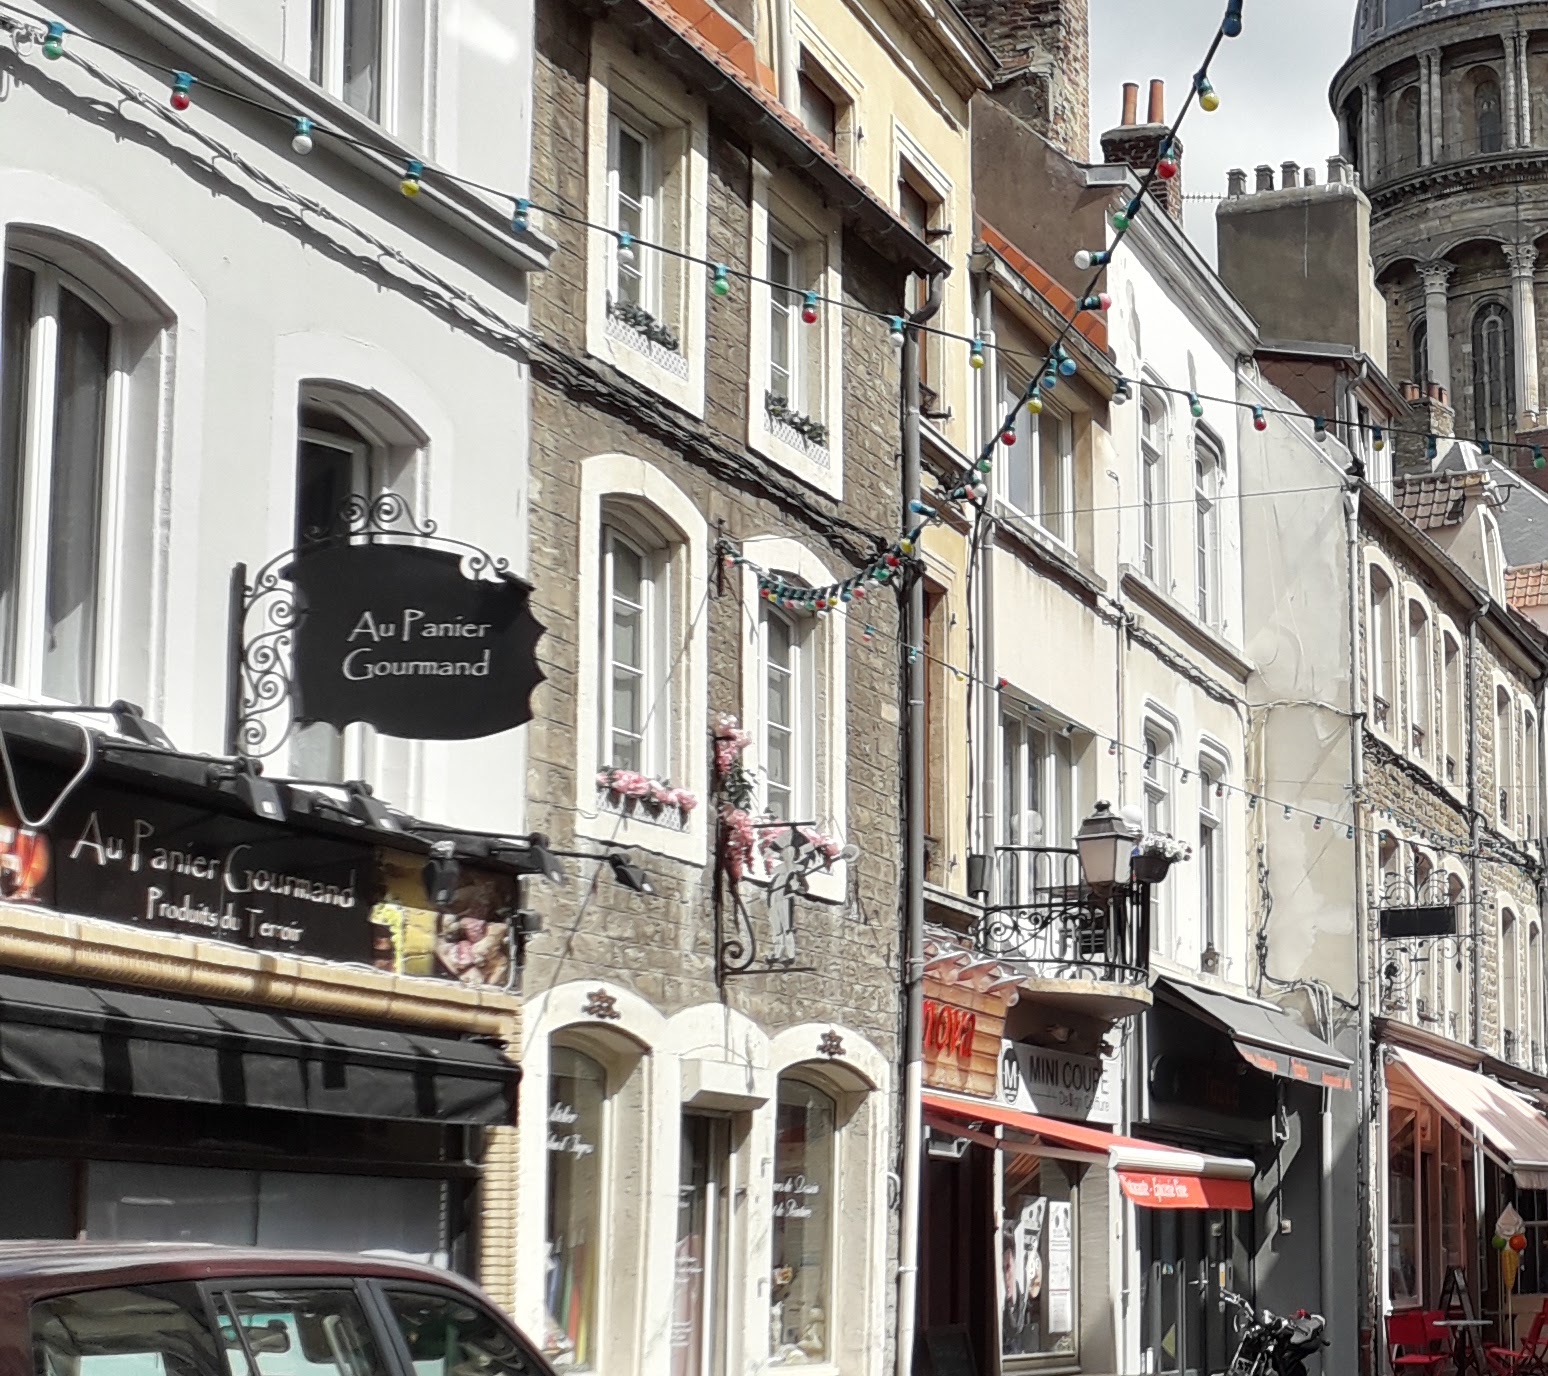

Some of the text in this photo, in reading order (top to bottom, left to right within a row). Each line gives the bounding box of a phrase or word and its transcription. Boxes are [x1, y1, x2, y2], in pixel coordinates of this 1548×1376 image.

[346, 609, 493, 642] Au Panier
[342, 647, 492, 681] Gourmand
[70, 811, 356, 908] Au Panier Gourmand
[146, 887, 304, 942] Produits du Terroir
[1029, 1055, 1111, 1096] MINI COUPE
